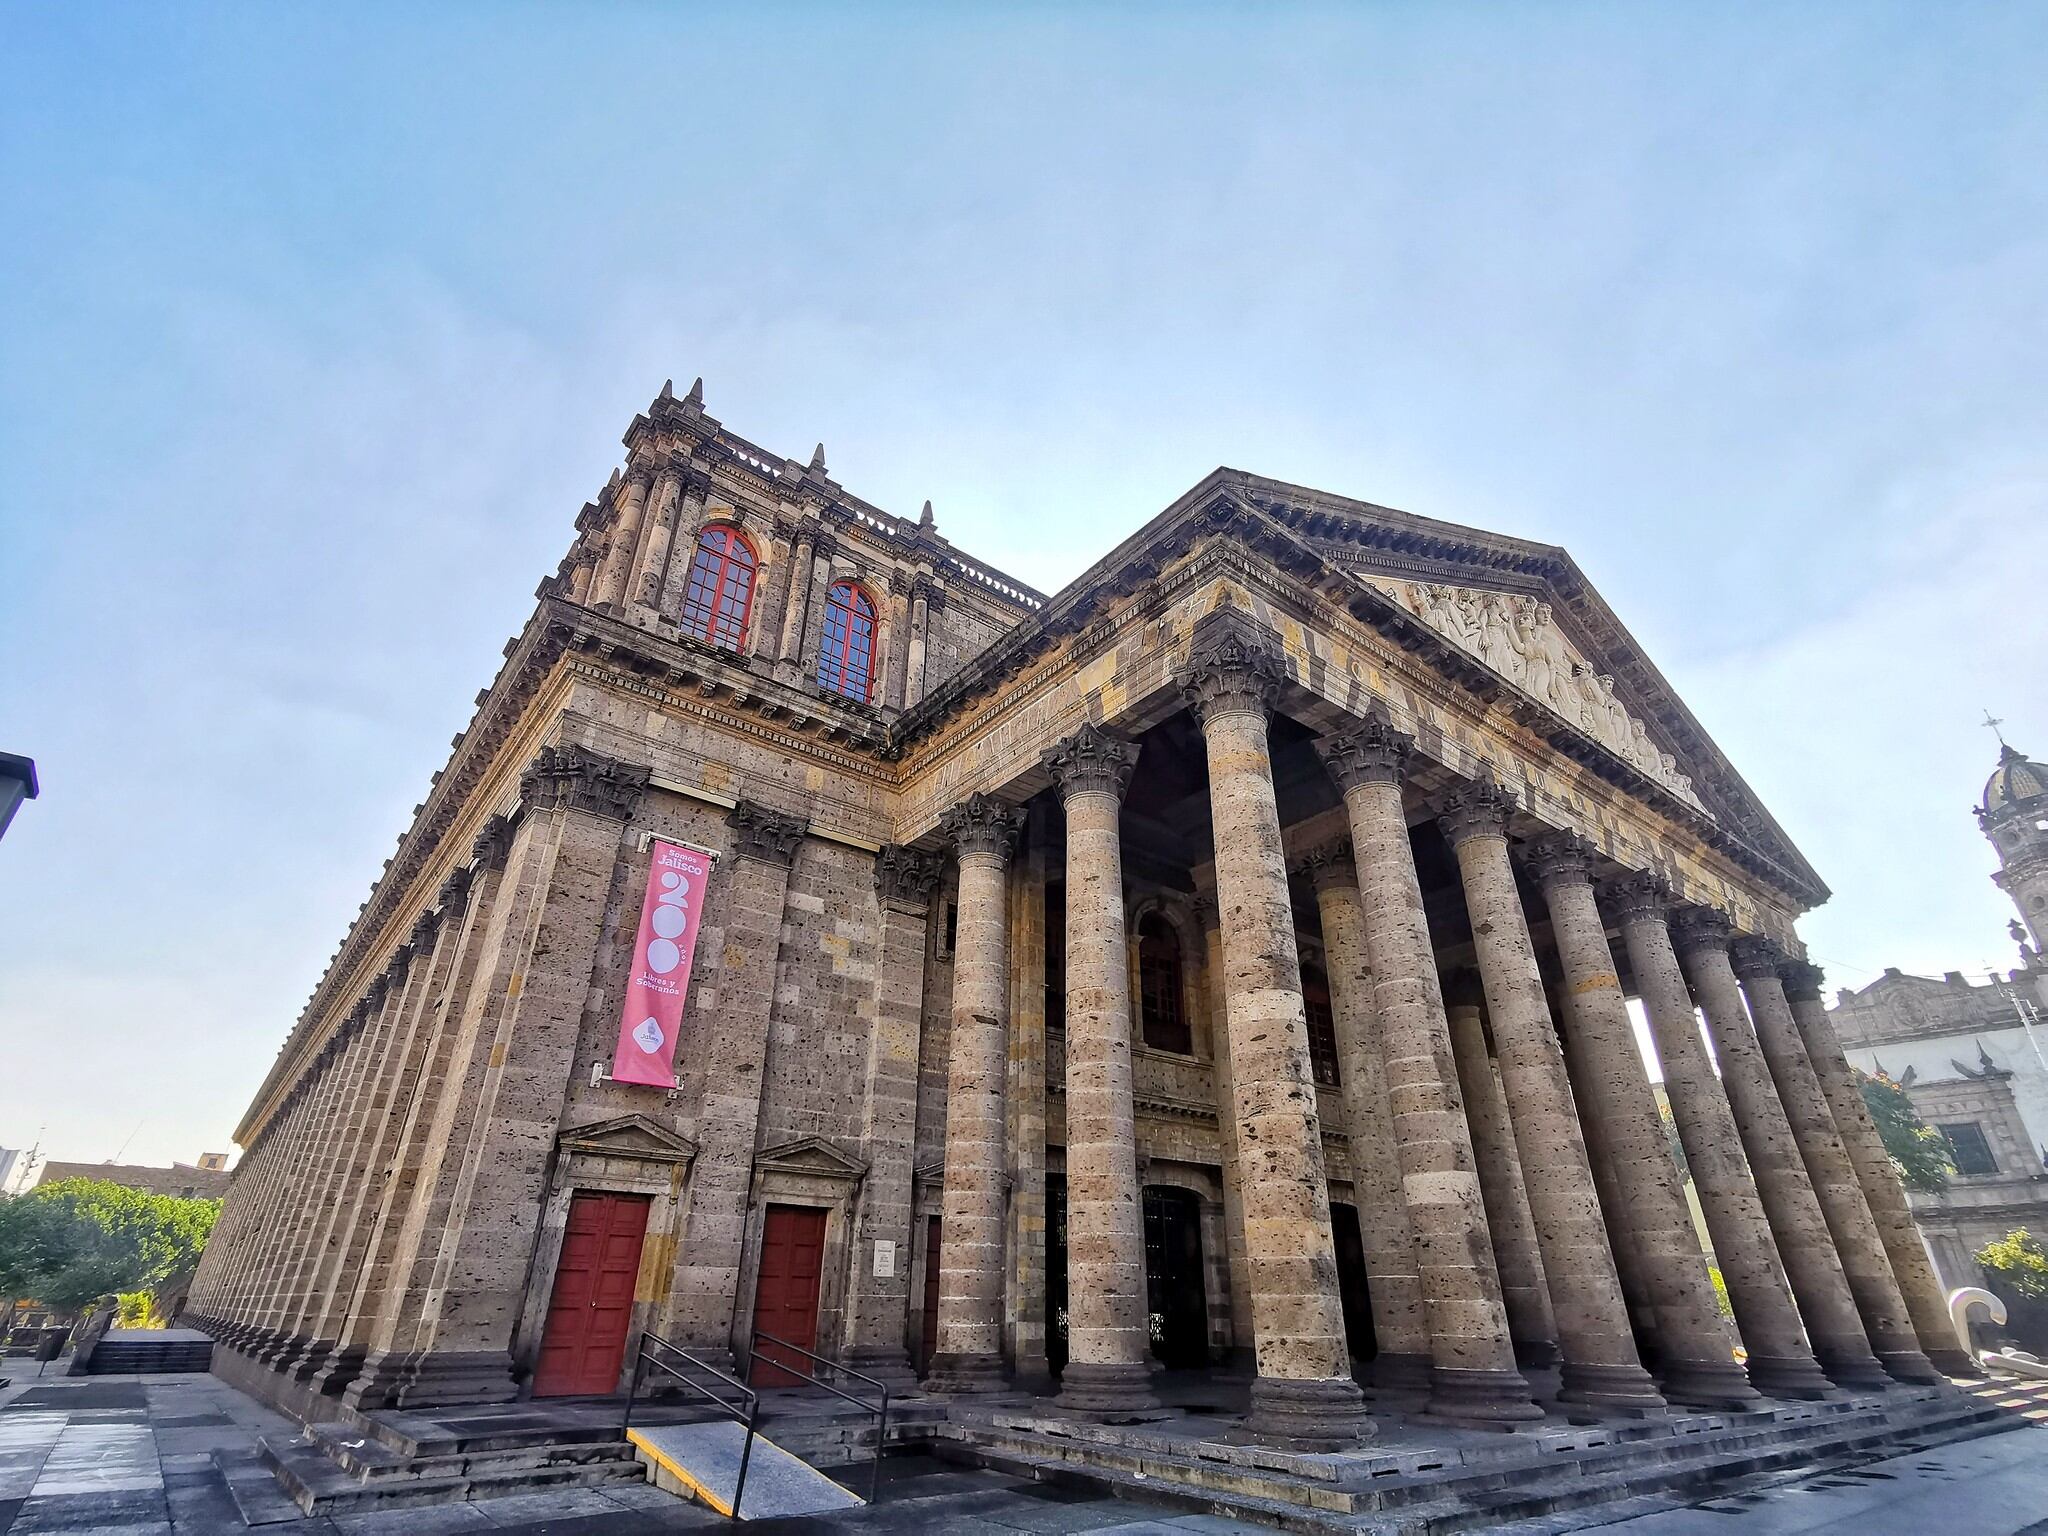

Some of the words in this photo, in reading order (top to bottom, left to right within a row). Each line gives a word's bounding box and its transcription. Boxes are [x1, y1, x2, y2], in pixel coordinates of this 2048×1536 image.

[658, 854, 702, 875] Jalisco
[669, 849, 697, 863] Somos
[636, 977, 679, 995] Soberanos
[643, 971, 667, 986] Libres
[670, 980, 676, 988] y
